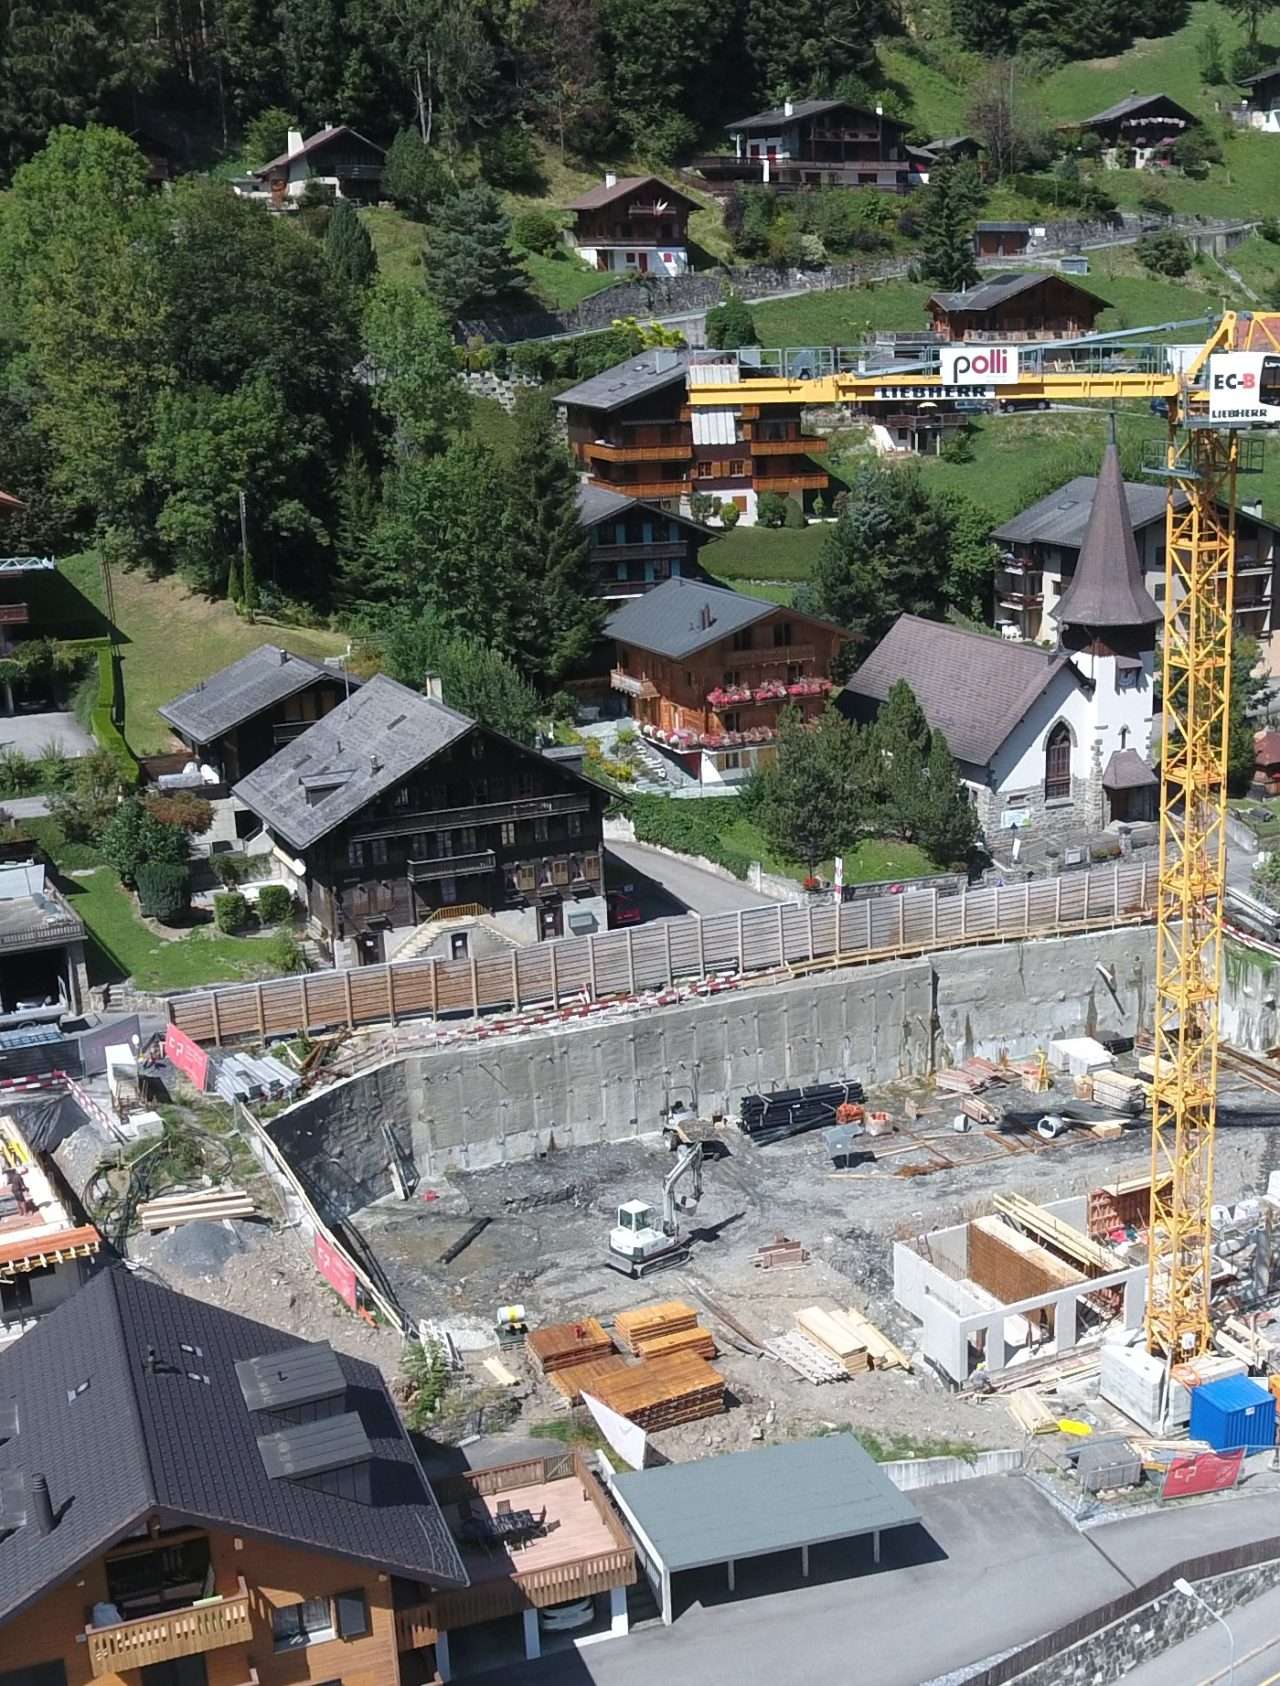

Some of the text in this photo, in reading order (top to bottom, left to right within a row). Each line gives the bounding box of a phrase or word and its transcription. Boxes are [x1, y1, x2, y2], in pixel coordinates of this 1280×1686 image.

[953, 349, 1007, 383] polli
[1214, 373, 1255, 390] EC-B
[881, 386, 986, 398] LIEBHERR
[1212, 409, 1267, 419] LIEBHERR
